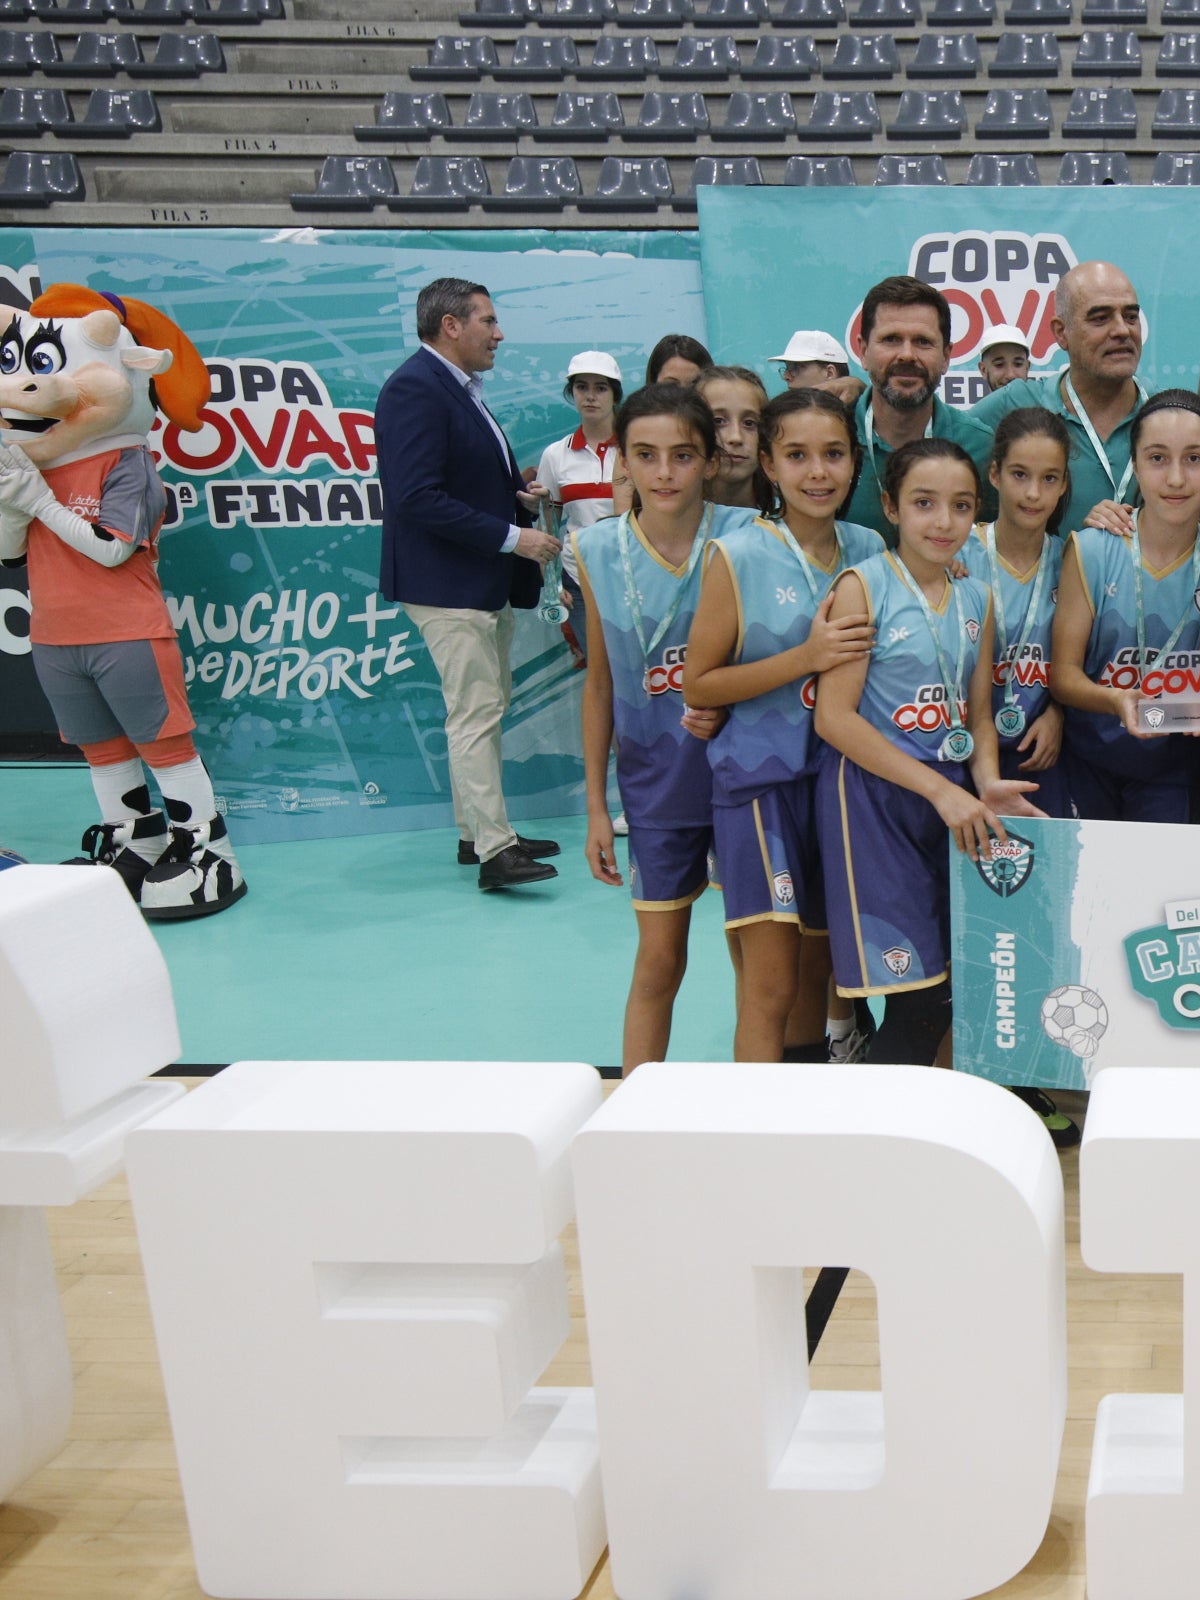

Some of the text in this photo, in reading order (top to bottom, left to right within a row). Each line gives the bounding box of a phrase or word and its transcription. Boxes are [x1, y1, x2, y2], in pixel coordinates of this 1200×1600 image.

[346, 25, 396, 36] FILA 6
[288, 79, 323, 90] FILA
[224, 139, 277, 150] FILA 4
[151, 208, 191, 221] FILA
[914, 238, 1071, 284] COPA
[206, 364, 324, 406] OPA
[150, 408, 378, 472] OVAP
[1176, 907, 1199, 922] Del
[990, 933, 1016, 1049] CAMPEÓN
